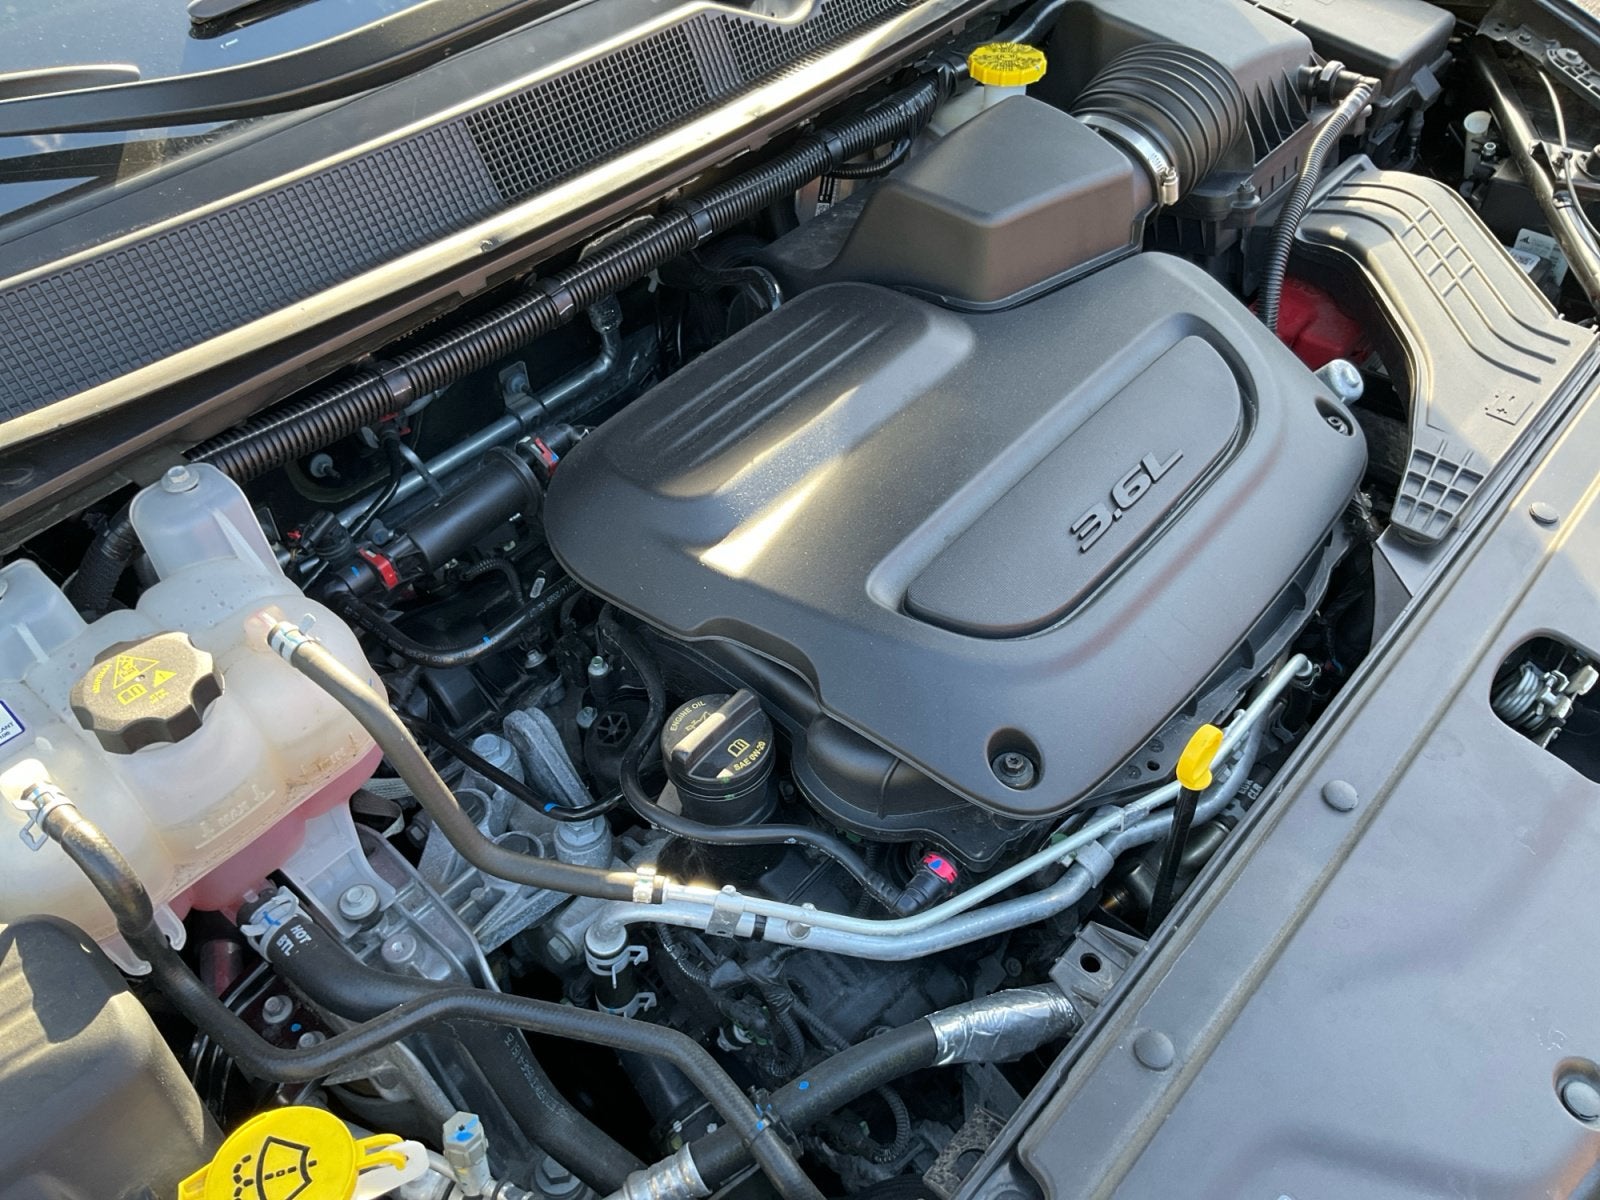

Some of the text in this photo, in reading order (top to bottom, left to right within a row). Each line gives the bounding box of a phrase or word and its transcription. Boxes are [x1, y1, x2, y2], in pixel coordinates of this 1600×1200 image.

[1069, 448, 1184, 555] 3.6L
[670, 701, 706, 731] ENGINE OIL
[734, 758, 751, 770] SAE
[1247, 783, 1263, 800] CLR
[290, 924, 311, 943] HOT
[276, 933, 294, 956] BTL
